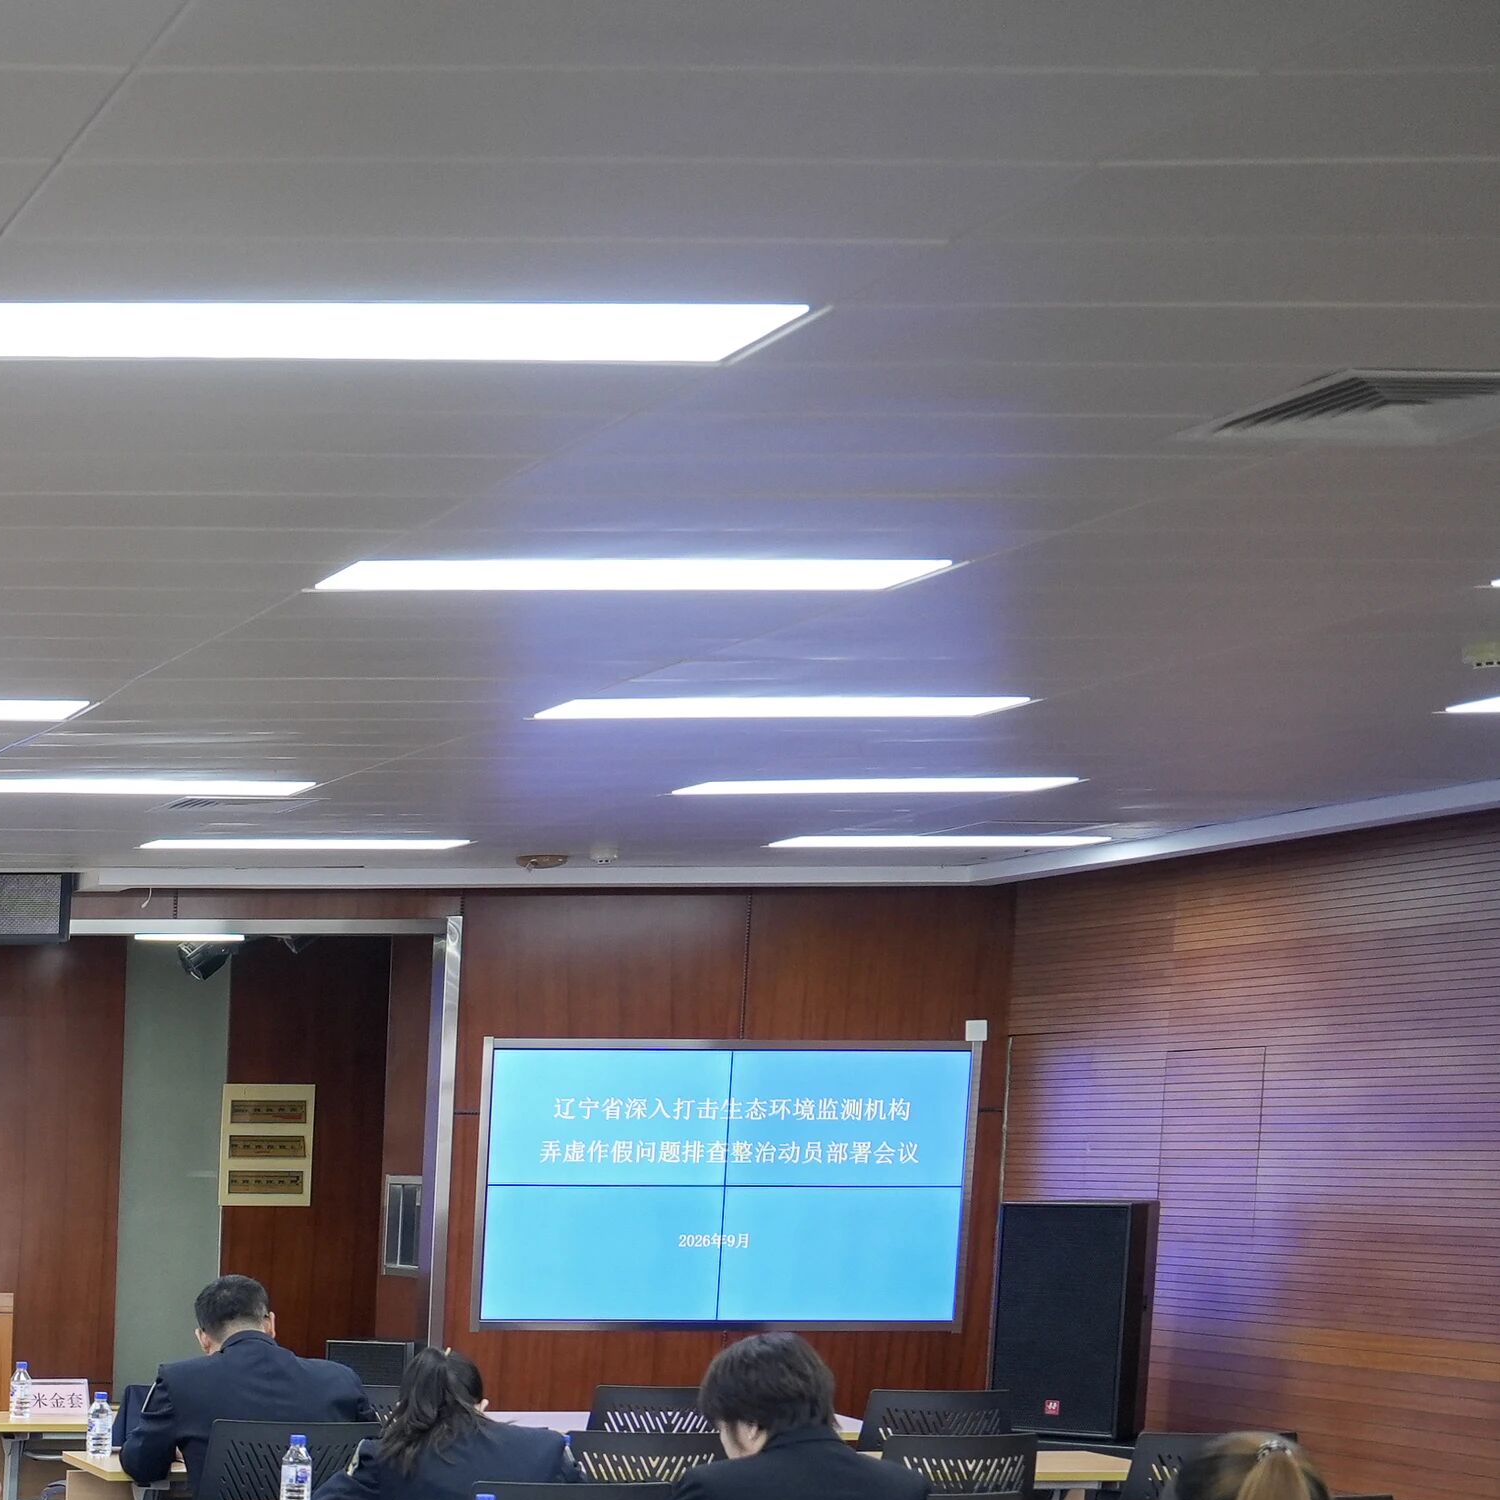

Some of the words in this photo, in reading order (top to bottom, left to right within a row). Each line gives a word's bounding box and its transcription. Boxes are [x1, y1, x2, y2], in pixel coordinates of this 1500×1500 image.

[552, 1097, 911, 1121] 辽宁省深入打击生态环境监测机构
[539, 1140, 919, 1164] 弄虚作假问题排查整治动员部署会议
[678, 1232, 750, 1249] 2026年9月
